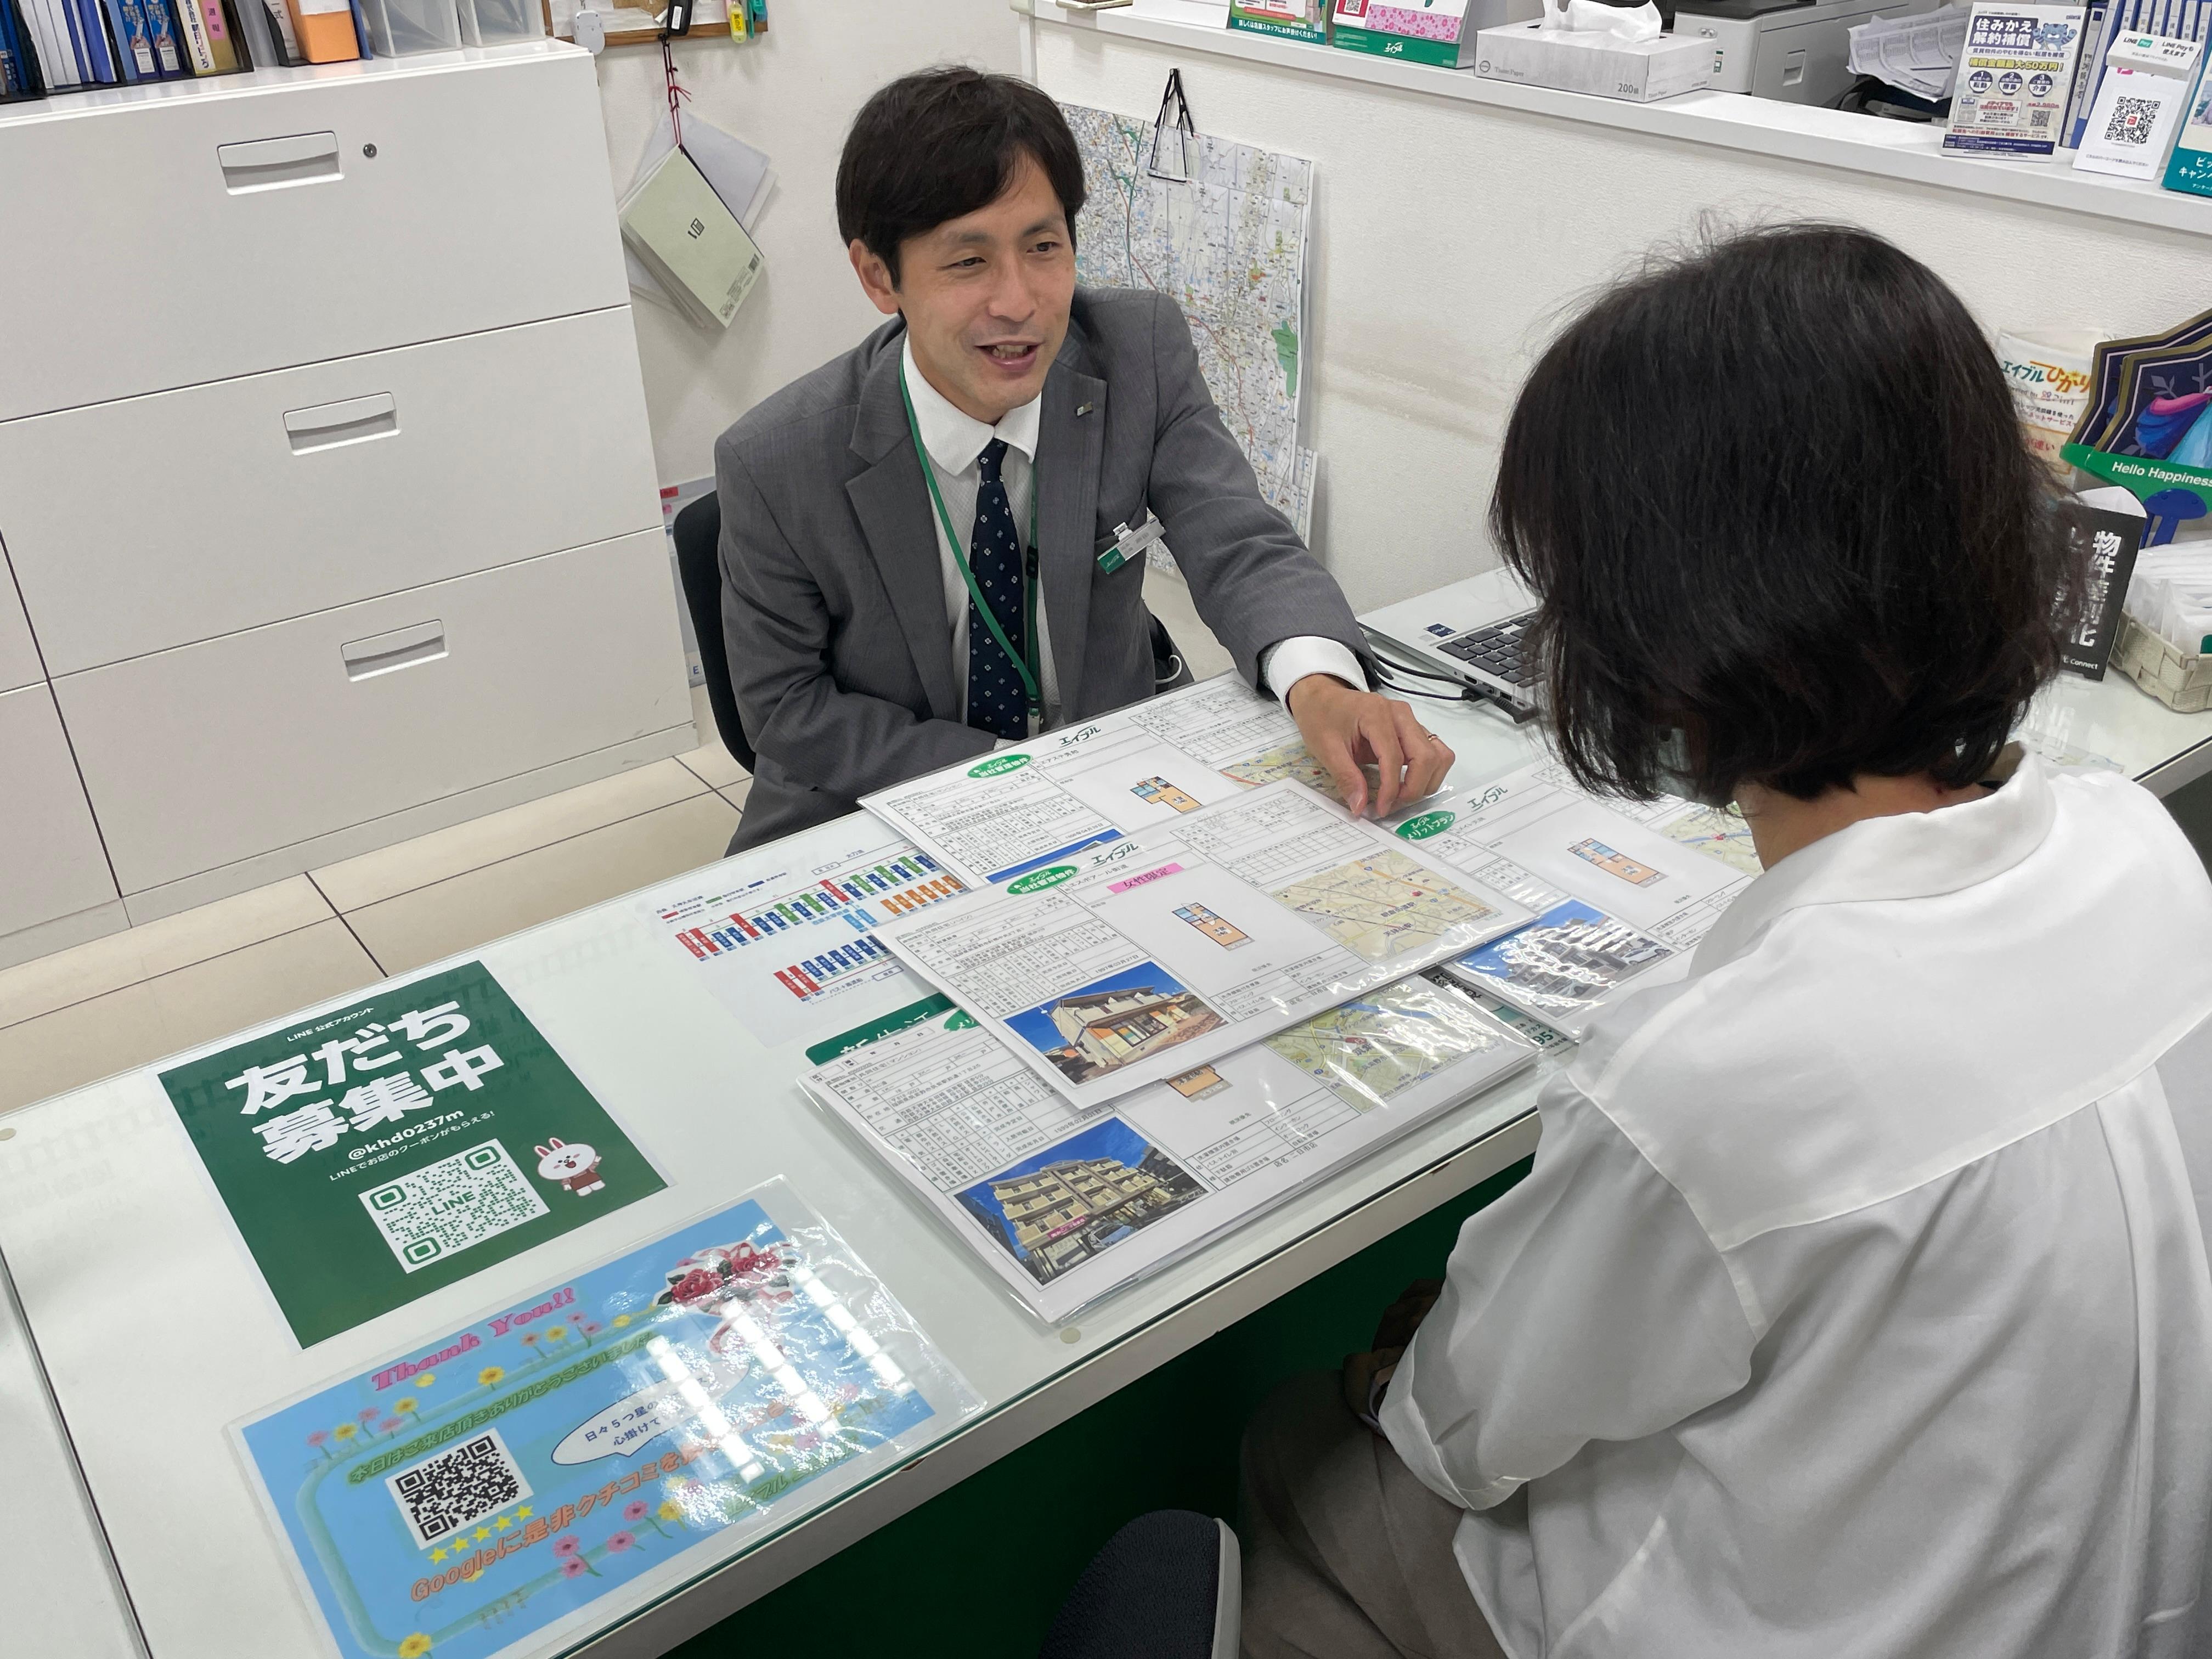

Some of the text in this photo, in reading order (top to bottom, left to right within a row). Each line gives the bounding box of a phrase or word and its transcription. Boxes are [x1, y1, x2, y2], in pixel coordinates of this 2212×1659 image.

[1976, 18, 2032, 32] 住みかえ
[1973, 32, 2031, 47] 解約補償
[2112, 461, 2212, 488] Hello Happiness
[2070, 658, 2098, 670] Connect
[1059, 724, 1101, 748] エイブル
[978, 756, 1029, 777] 当社管理物件
[1468, 785, 1508, 812] エイブル
[1407, 814, 1454, 840] メリットプラン
[1410, 815, 1430, 828] エイブル
[1091, 841, 1138, 868] エイブル
[1019, 869, 1075, 894] 当社管理物件
[1124, 868, 1172, 888] 女性限定
[287, 1006, 375, 1043] LINE 公式アカウント
[225, 1001, 471, 1115] 友だち
[252, 1044, 505, 1165] 募集中
[348, 1109, 465, 1161] @khd0237m
[992, 1115, 1024, 1132] 完成予定日
[329, 1110, 495, 1182] LINEでお店のクーポンがもらえる!
[1014, 1136, 1046, 1153] 完成年月日
[1274, 1142, 1318, 1167] 店名 二日市店
[431, 1191, 476, 1217] LINE
[371, 1287, 576, 1392] Thank You!!
